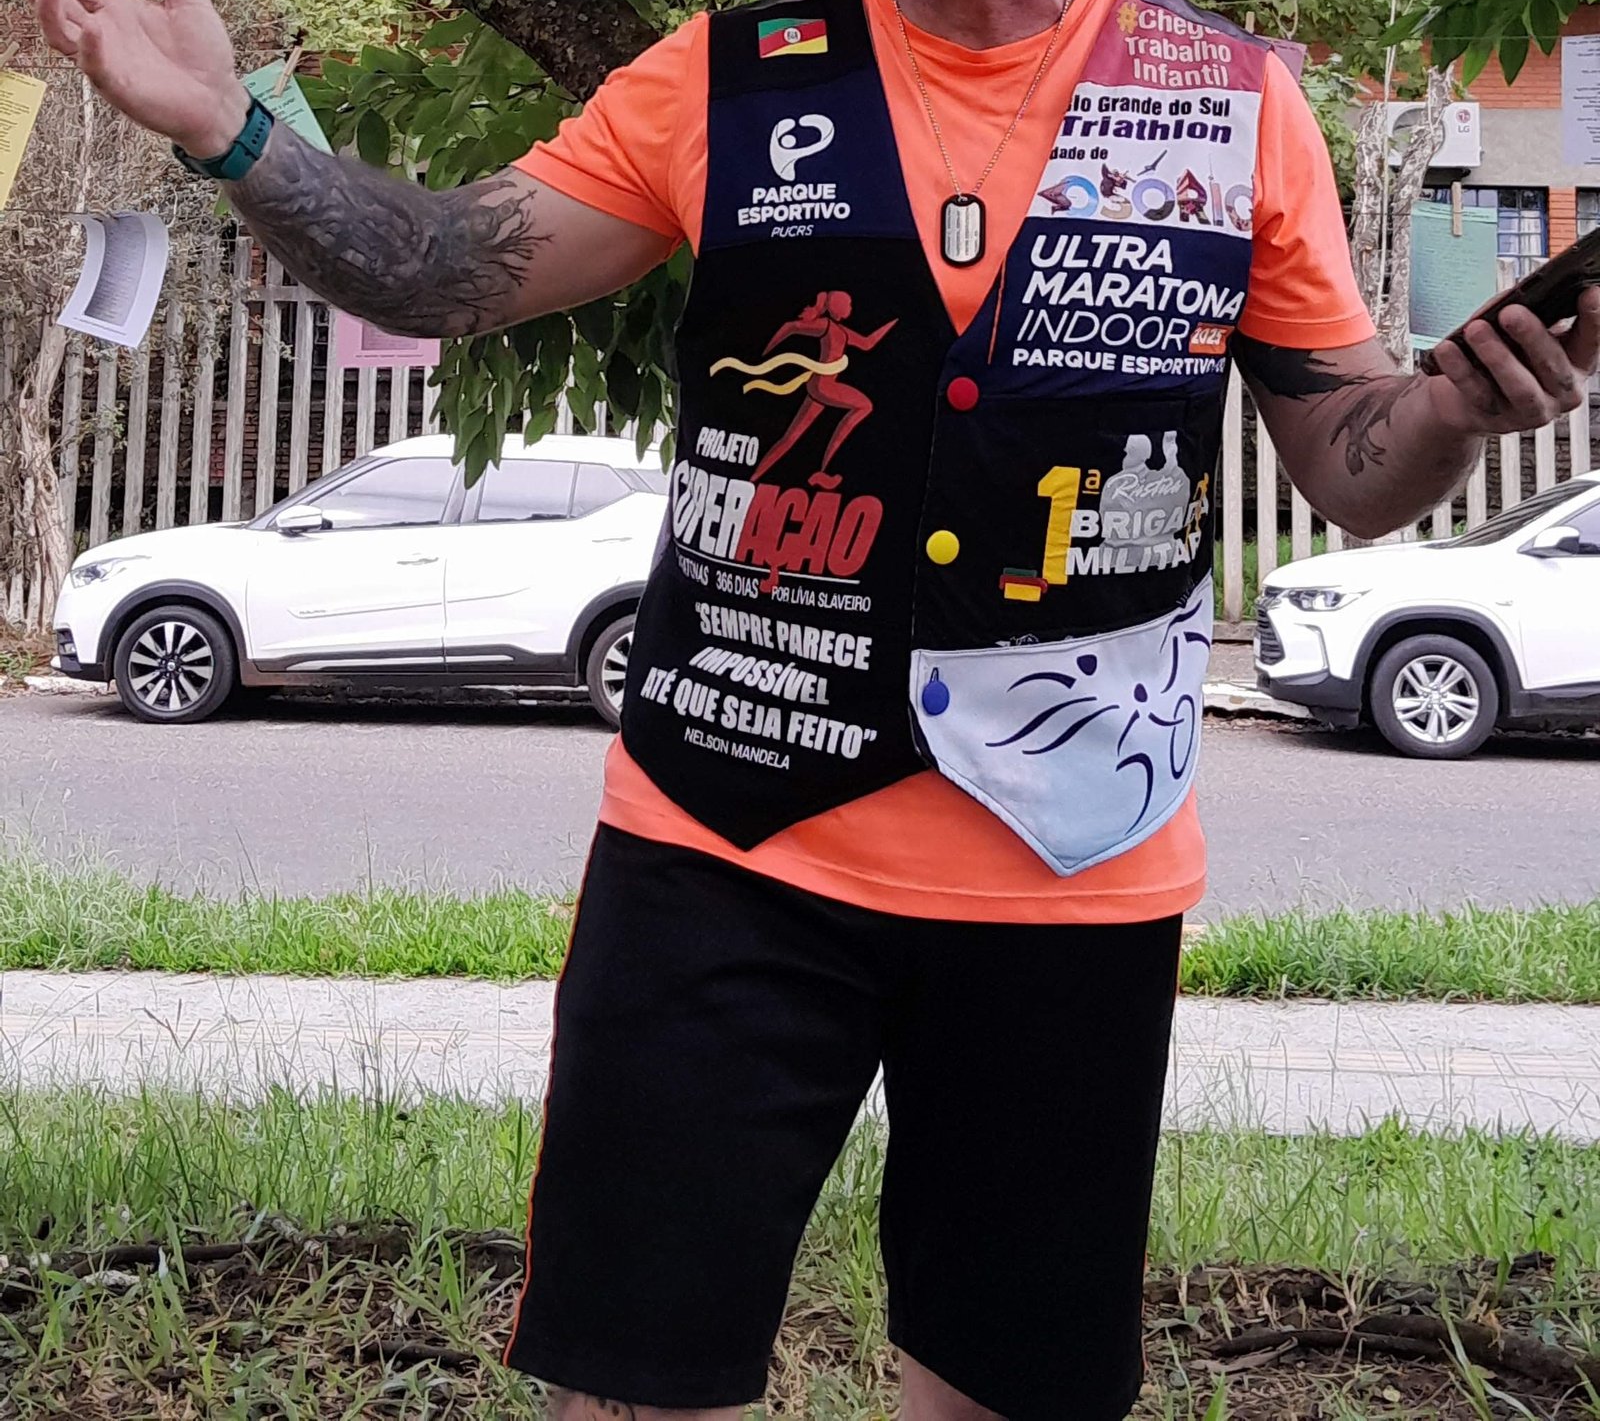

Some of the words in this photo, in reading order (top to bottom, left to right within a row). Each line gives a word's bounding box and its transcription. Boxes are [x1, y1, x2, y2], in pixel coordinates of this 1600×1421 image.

[1125, 36, 1231, 62] Trabalho
[1134, 59, 1229, 87] Infantil
[1098, 95, 1162, 116] Grande
[1168, 98, 1192, 116] do
[1199, 96, 1231, 118] Sul
[1061, 116, 1231, 143] Triathlon
[1457, 124, 1472, 134] LG
[1090, 146, 1109, 161] de
[752, 183, 837, 205] PARQUE
[737, 202, 851, 226] ESPORTIVO
[770, 224, 814, 238] PUCRS
[1031, 235, 1173, 274] ULTRA
[1022, 271, 1245, 321] MARATONA
[1017, 310, 1190, 351] INDOOR
[1190, 326, 1228, 346] 2025
[1012, 348, 1117, 371] PARQUE
[697, 427, 759, 466] PROJETO
[716, 571, 732, 594] 366
[735, 575, 759, 599] DIAS
[770, 584, 790, 604] POR
[790, 586, 816, 608] LÍVIA
[817, 591, 872, 613] SLAVEIRO
[777, 620, 872, 671] PARECE
[689, 646, 829, 705] IMPOSSÍVEL
[641, 667, 679, 705] ATÉ
[673, 678, 720, 723] QUE
[721, 695, 781, 740] SEJA
[684, 726, 728, 755] NELSON
[731, 742, 790, 770] MANDELA
